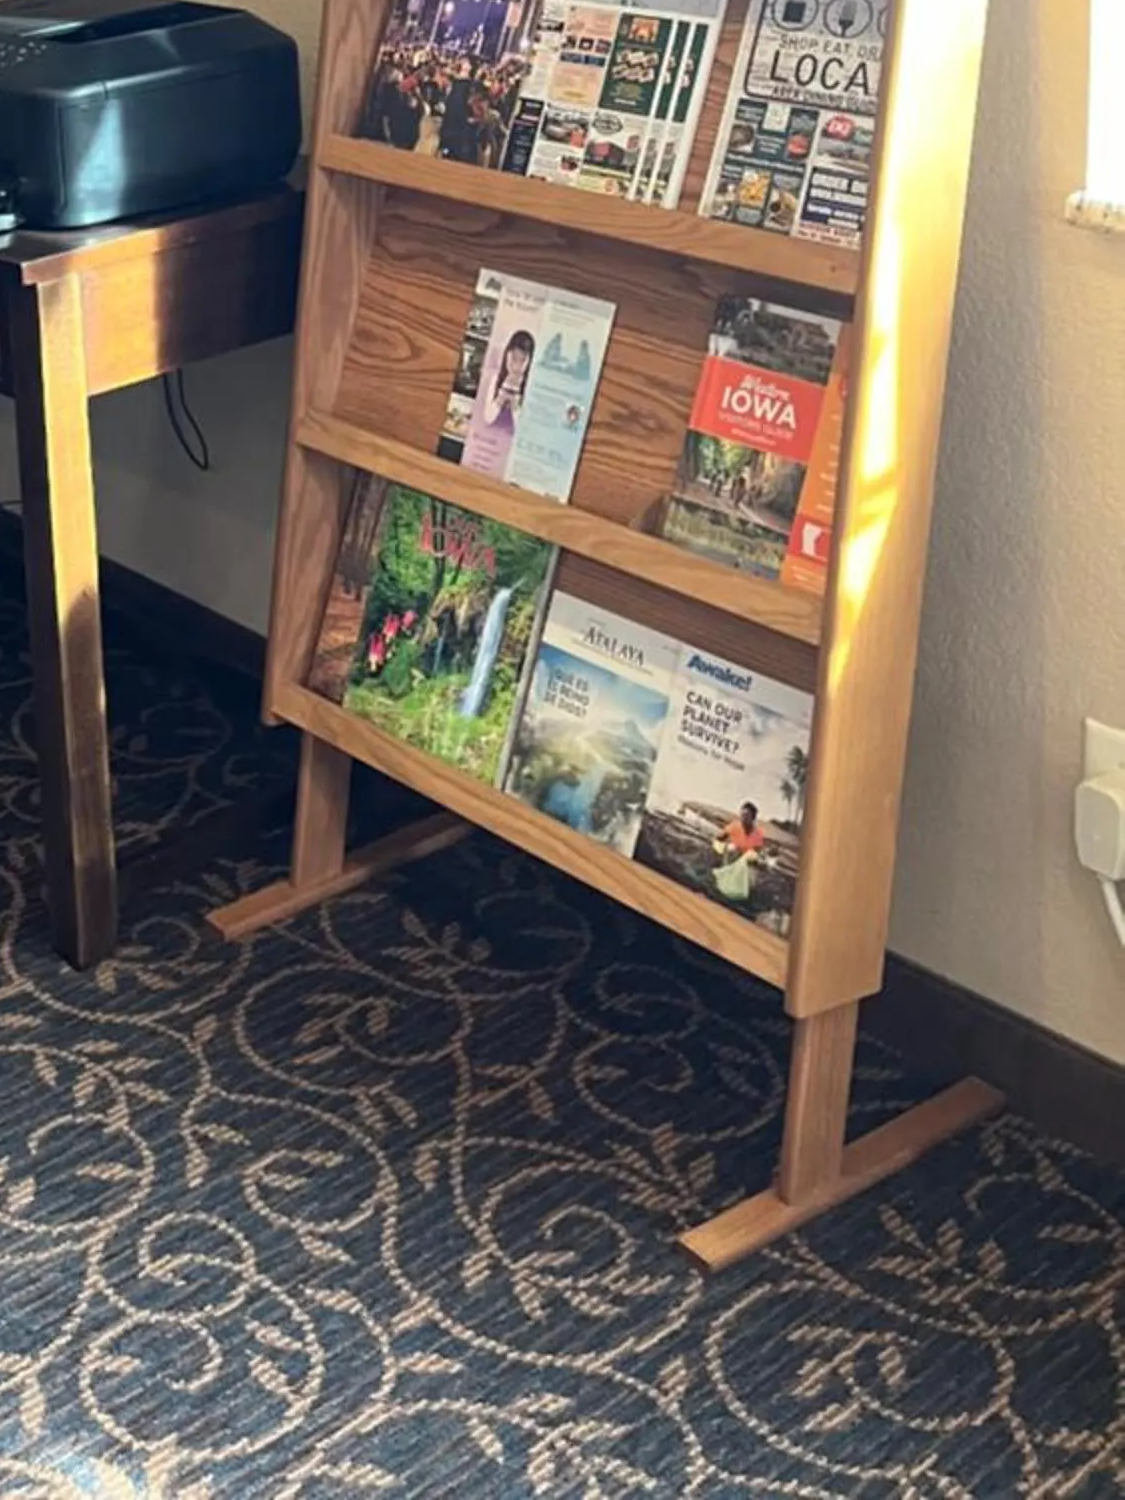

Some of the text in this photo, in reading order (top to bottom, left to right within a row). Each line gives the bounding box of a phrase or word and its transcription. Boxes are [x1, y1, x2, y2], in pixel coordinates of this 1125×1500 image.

[770, 49, 870, 96] LOCA
[721, 385, 797, 431] IOWA
[686, 652, 752, 693] Awake!
[682, 704, 730, 734] PLANET
[686, 690, 743, 724] CAN OUR
[680, 718, 740, 755] SURVIVE?
